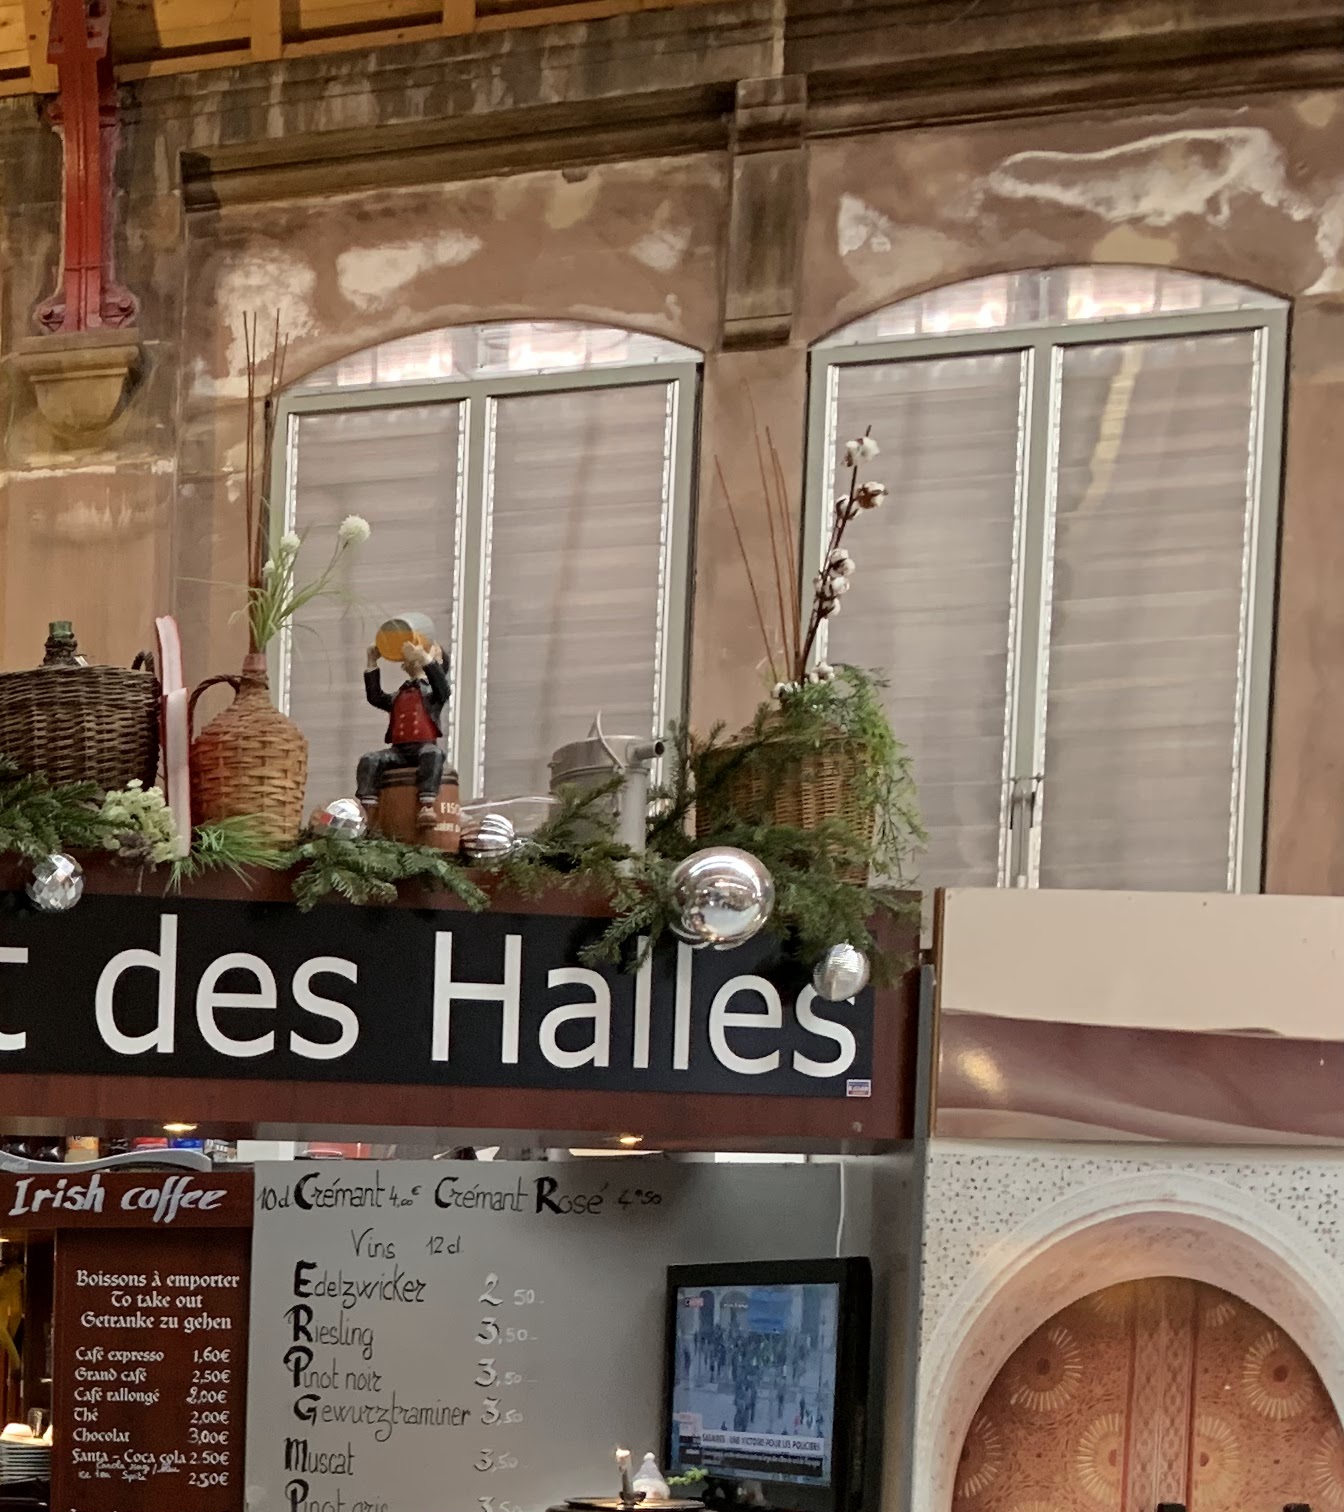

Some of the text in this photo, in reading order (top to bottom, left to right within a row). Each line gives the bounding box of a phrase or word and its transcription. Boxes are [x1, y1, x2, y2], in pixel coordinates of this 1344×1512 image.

[94, 913, 360, 1060] des
[431, 931, 857, 1078] Halles
[8, 1173, 228, 1224] Irish coffee
[293, 1169, 609, 1215] Crémant Crémant Rosé
[350, 1227, 396, 1259] Vins
[76, 1270, 240, 1291] Boissons à emporter
[293, 1259, 427, 1310] Edelzwicker
[111, 1291, 203, 1308] To take out
[81, 1311, 232, 1333] Getranke zu gehen
[283, 1303, 374, 1360] Riesling
[75, 1347, 231, 1365] Café expresso 1,60€
[283, 1345, 382, 1392] Pinot noir
[75, 1367, 231, 1384] Grand café 2,50€
[74, 1387, 103, 1404] Café
[107, 1388, 160, 1405] rallongé
[73, 1407, 230, 1425] Thé 2,00€
[293, 1391, 472, 1443] Gewurztraminer
[72, 1428, 131, 1442] Chocolat
[72, 1447, 187, 1465] Fanta Coca cola
[283, 1437, 356, 1475] Muscat
